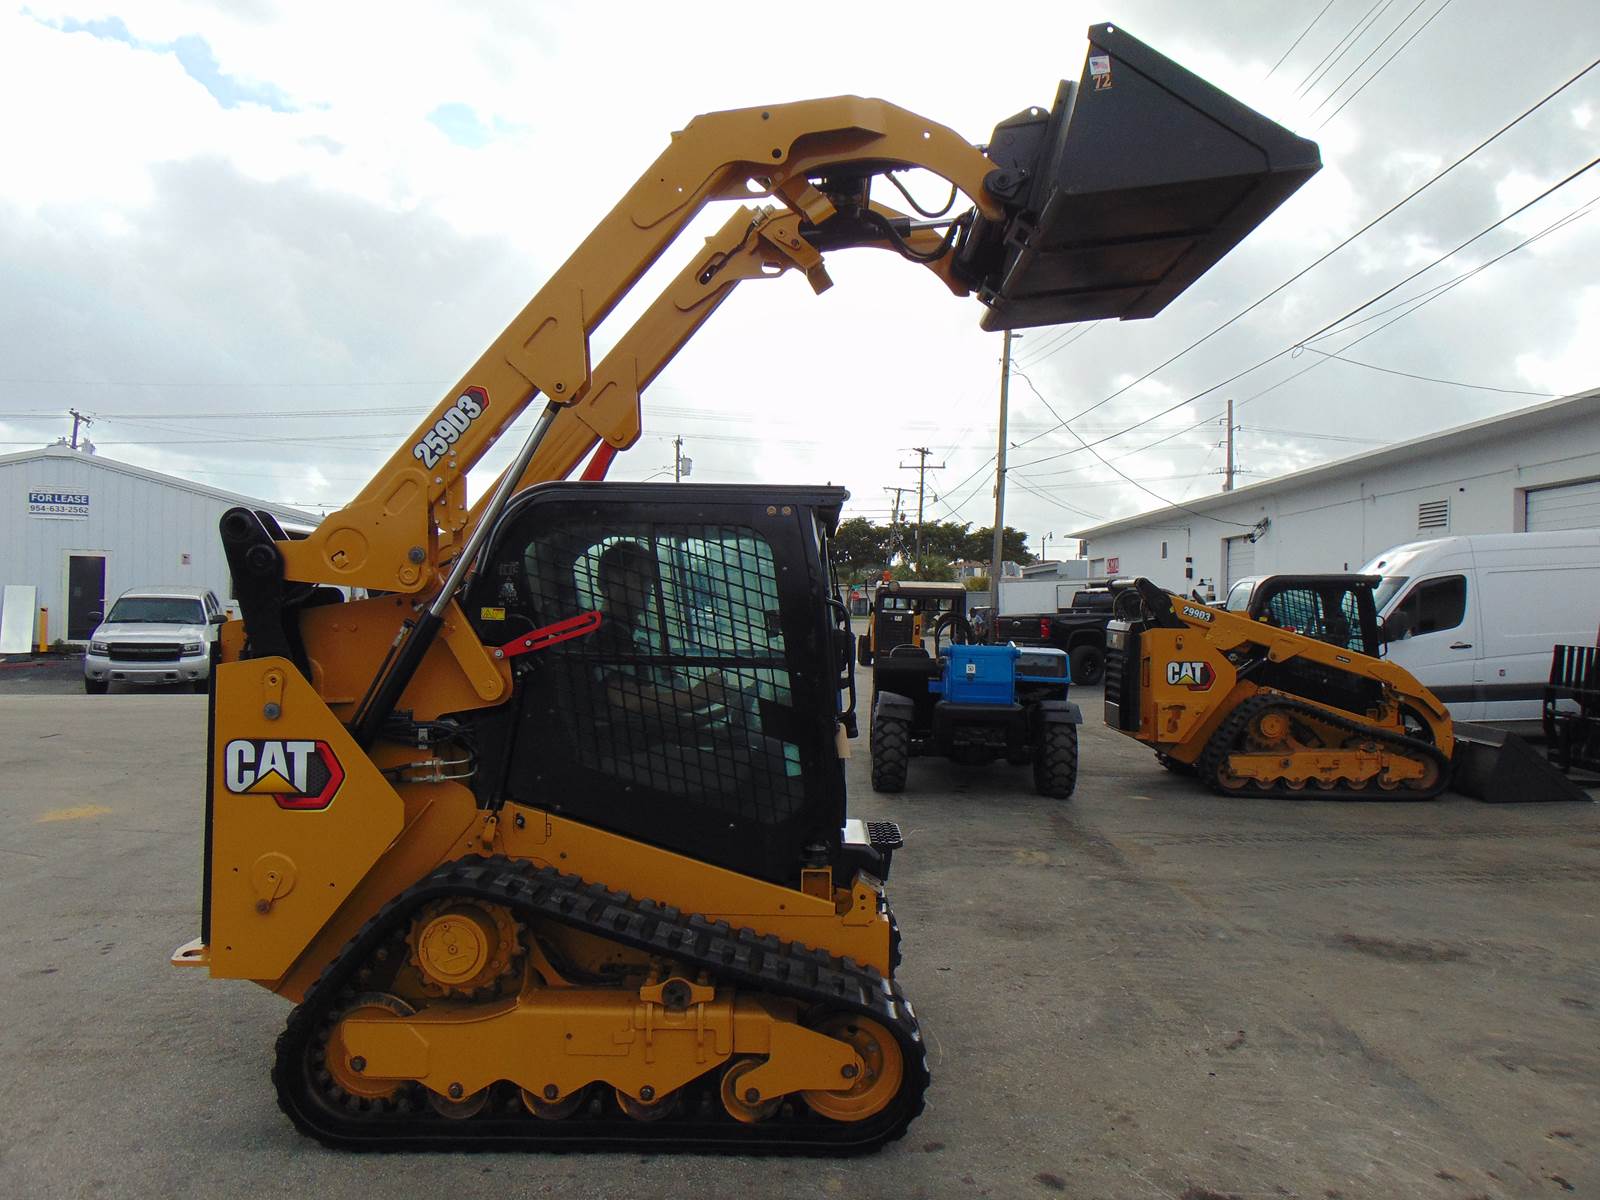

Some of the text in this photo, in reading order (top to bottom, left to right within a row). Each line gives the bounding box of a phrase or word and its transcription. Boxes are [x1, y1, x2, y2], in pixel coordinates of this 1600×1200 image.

[1093, 74, 1112, 89] 72
[413, 395, 482, 469] 259D3
[31, 493, 88, 504] FOR LEASE
[30, 504, 88, 514] 954-633-2562
[1167, 662, 1204, 685] CAT
[226, 740, 315, 793] CAT
